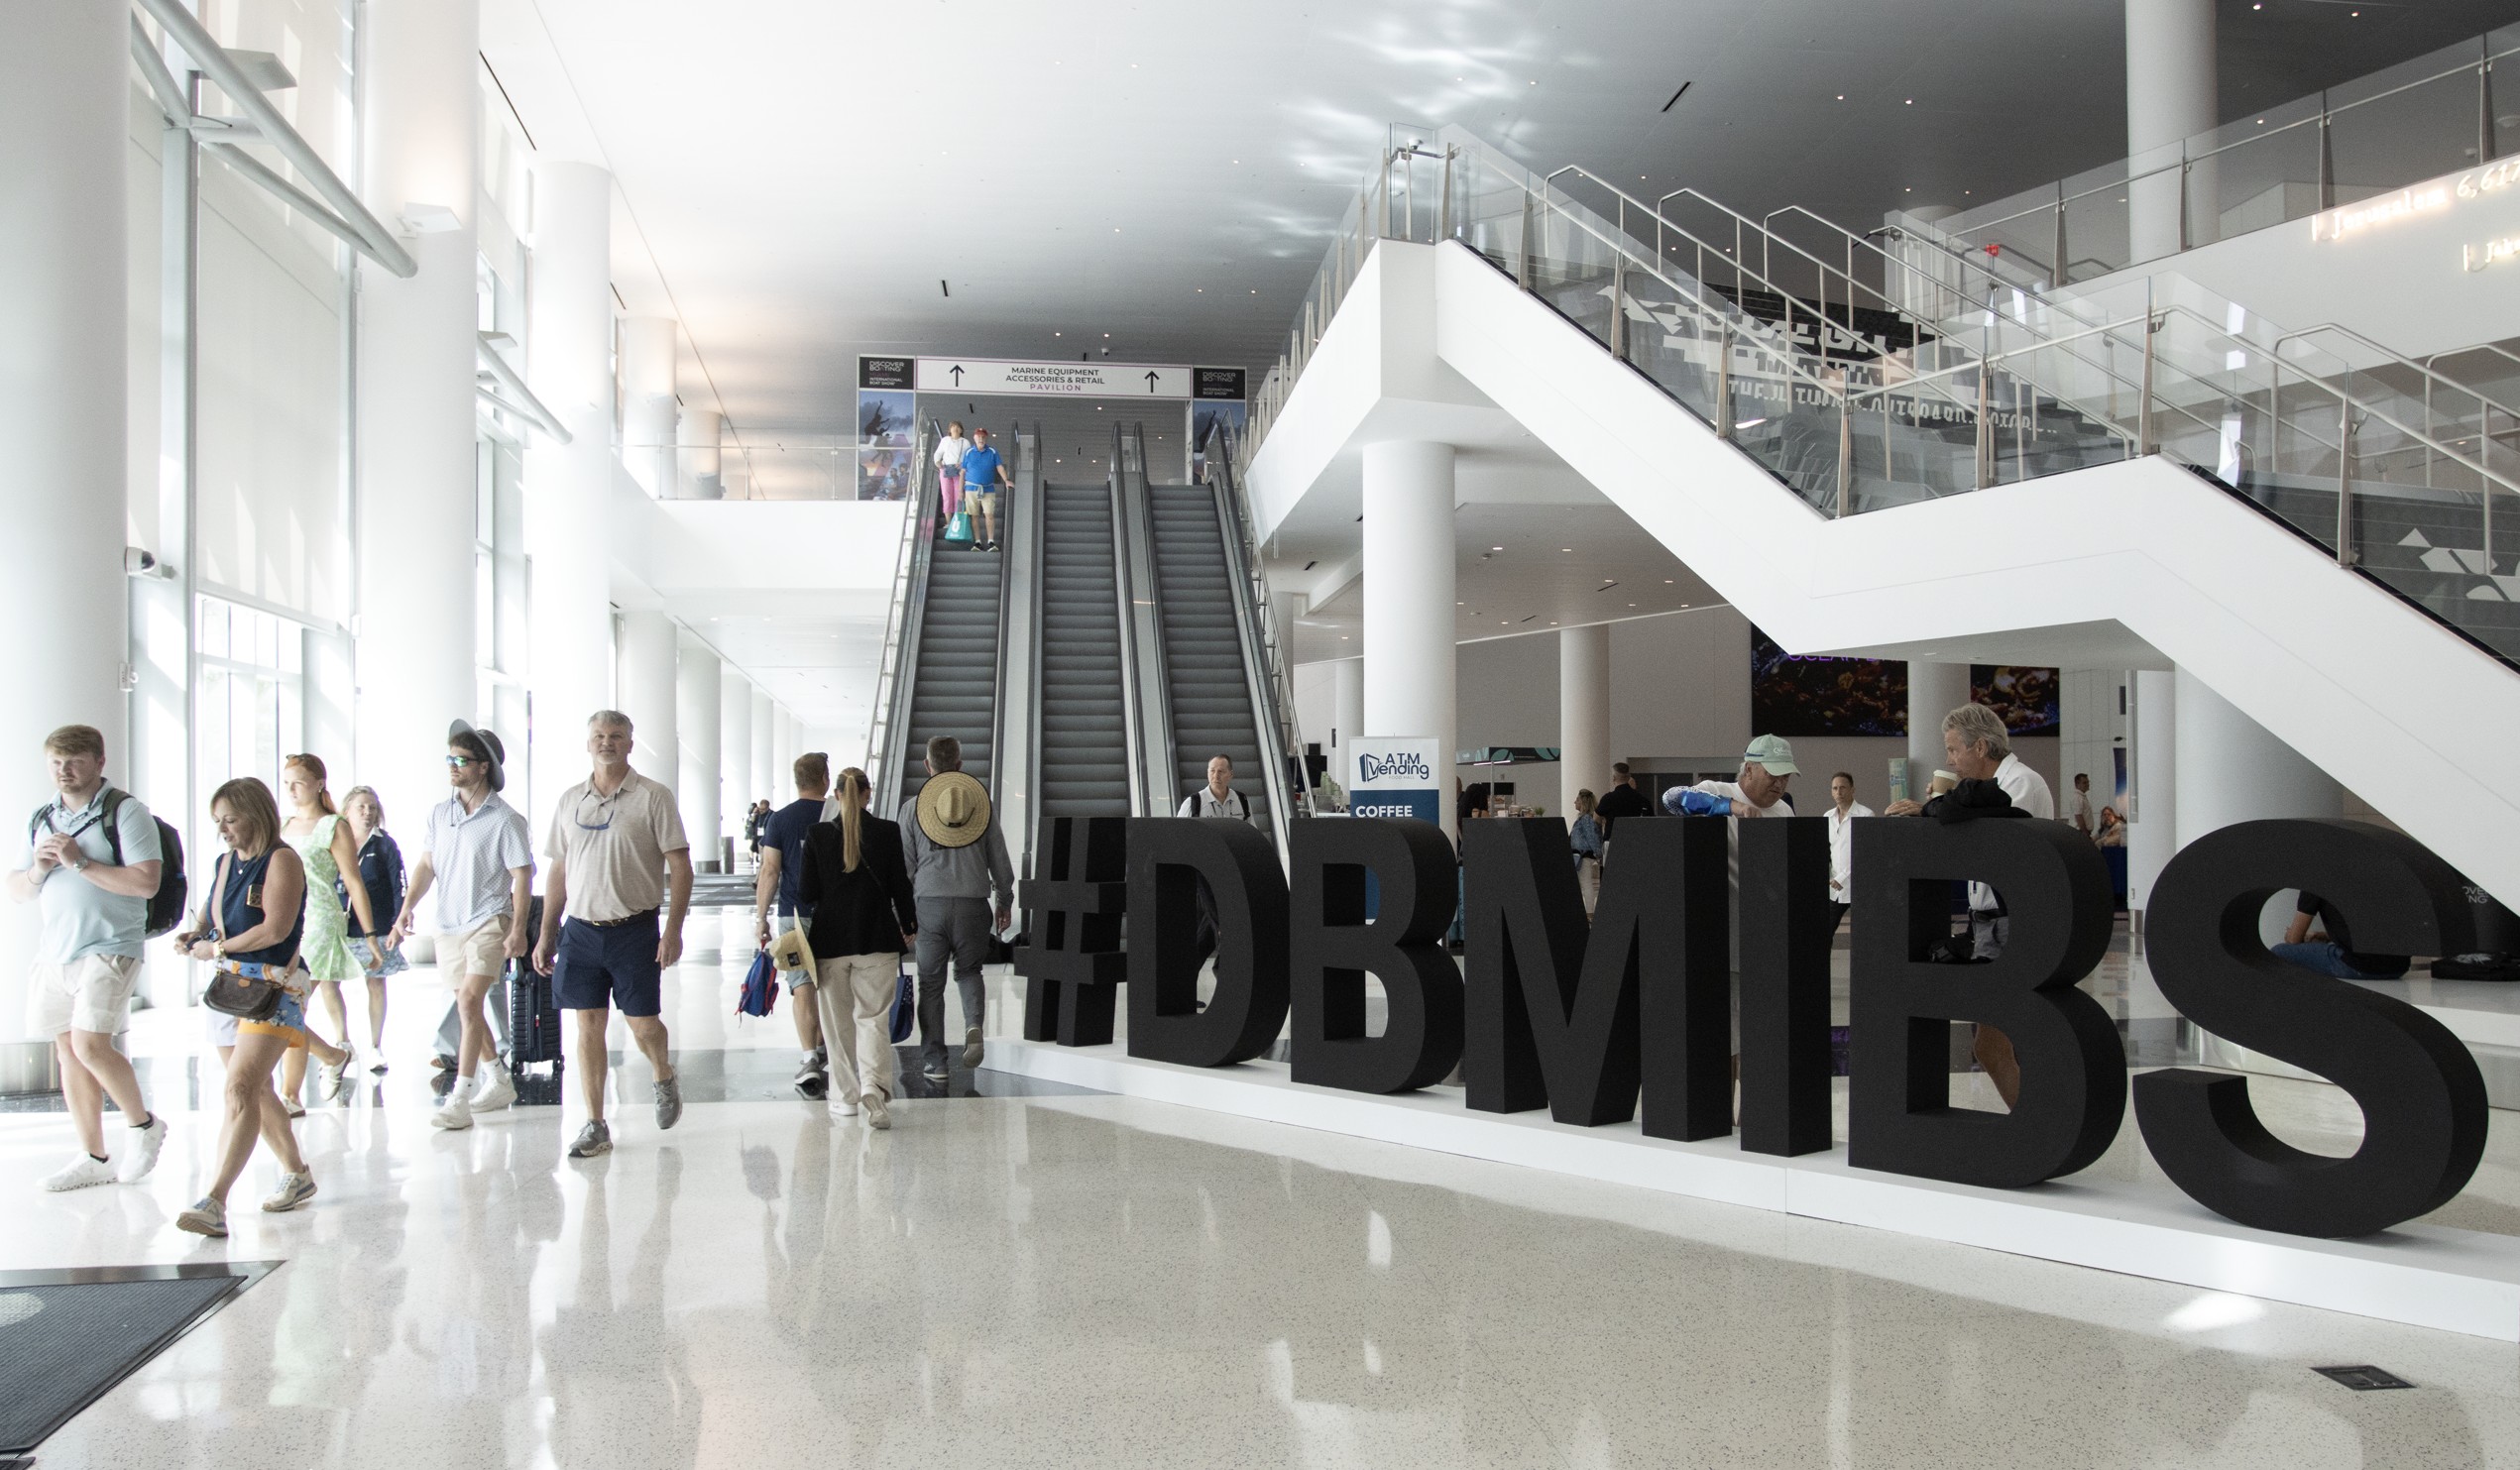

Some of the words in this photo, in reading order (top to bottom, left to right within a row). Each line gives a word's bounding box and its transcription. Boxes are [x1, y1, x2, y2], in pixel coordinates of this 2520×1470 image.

[2331, 188, 2448, 240] Jerusalem
[1048, 368, 1099, 377] EQUIPMENT
[1005, 375, 1066, 384] ACCESSORIES
[1075, 376, 1105, 385] RETAIL
[1385, 753, 1420, 765] ATM
[1369, 759, 1430, 780] Vending
[1355, 805, 1413, 818] COFFEE
[1013, 816, 2489, 1239] #DBMIBS
